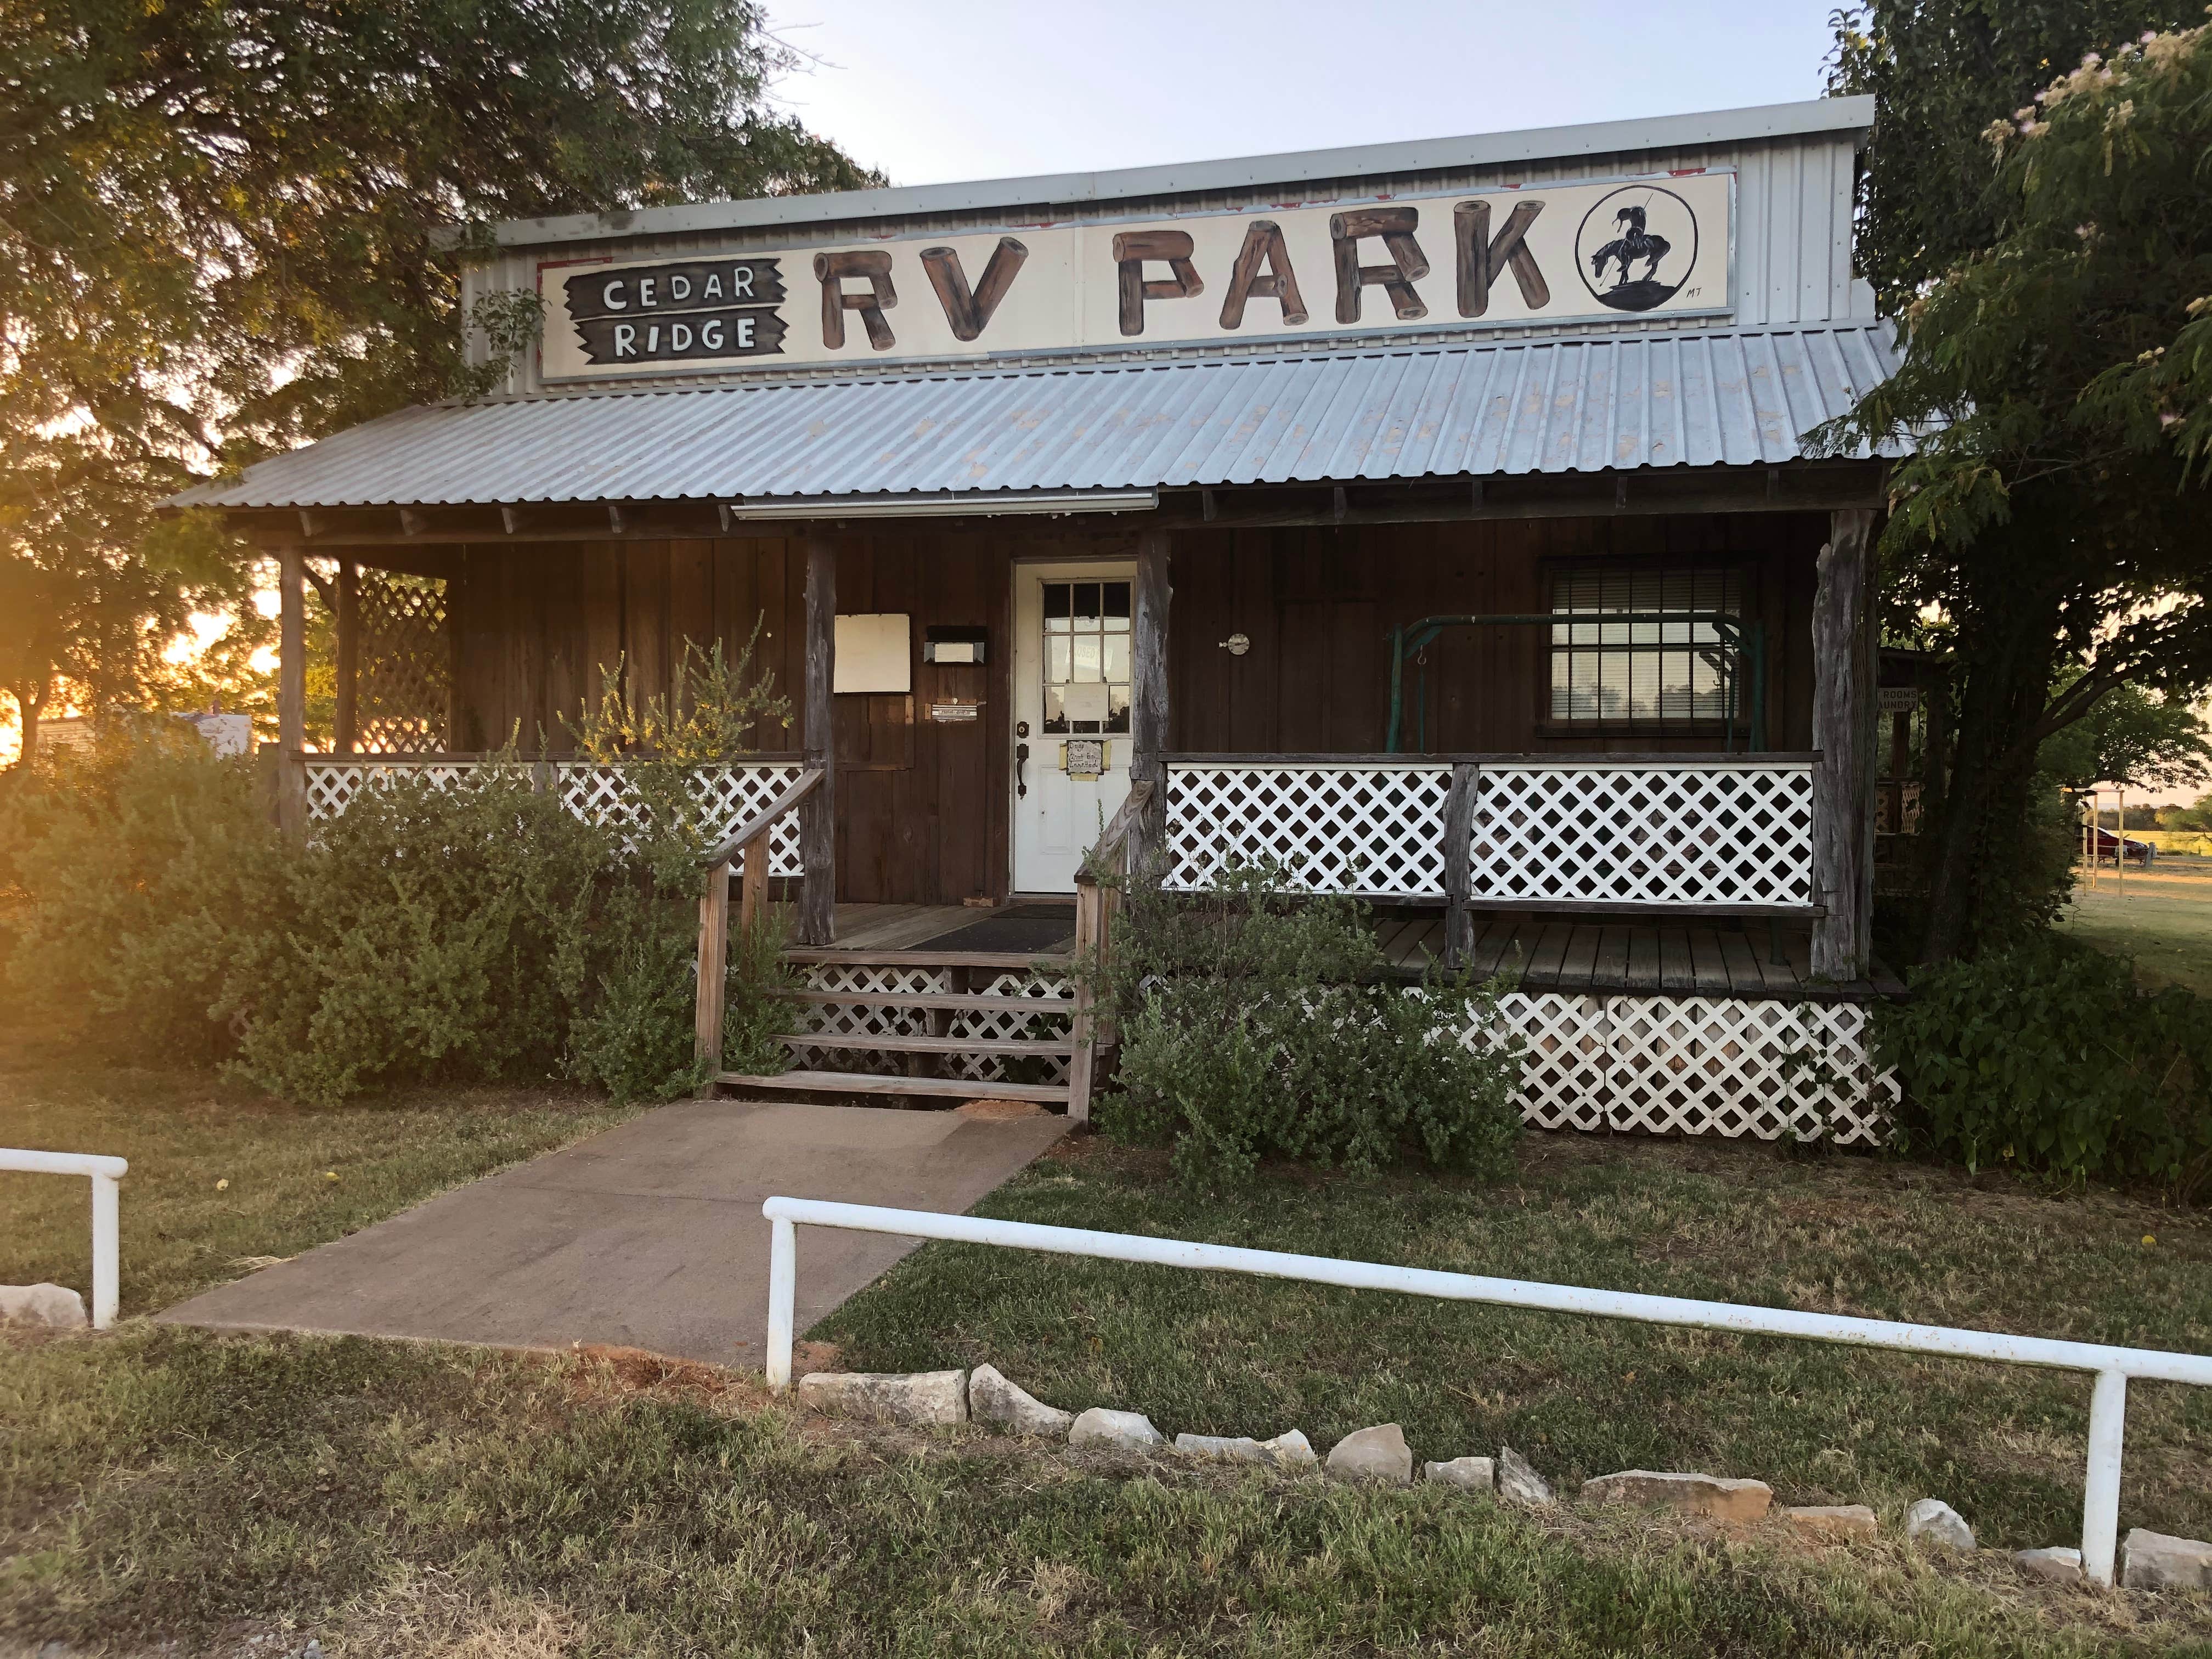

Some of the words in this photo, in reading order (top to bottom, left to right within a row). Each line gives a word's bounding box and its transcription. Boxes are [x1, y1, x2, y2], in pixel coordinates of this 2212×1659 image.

[813, 236, 1029, 351] RV
[1113, 199, 1547, 337] PARK
[603, 266, 755, 311] CEDAR
[1686, 287, 1702, 298] MT
[614, 318, 756, 358] RIDGE
[1074, 645, 1096, 658] OSED
[1883, 690, 1917, 698] ROOMS
[1878, 701, 1916, 709] AUNDRY
